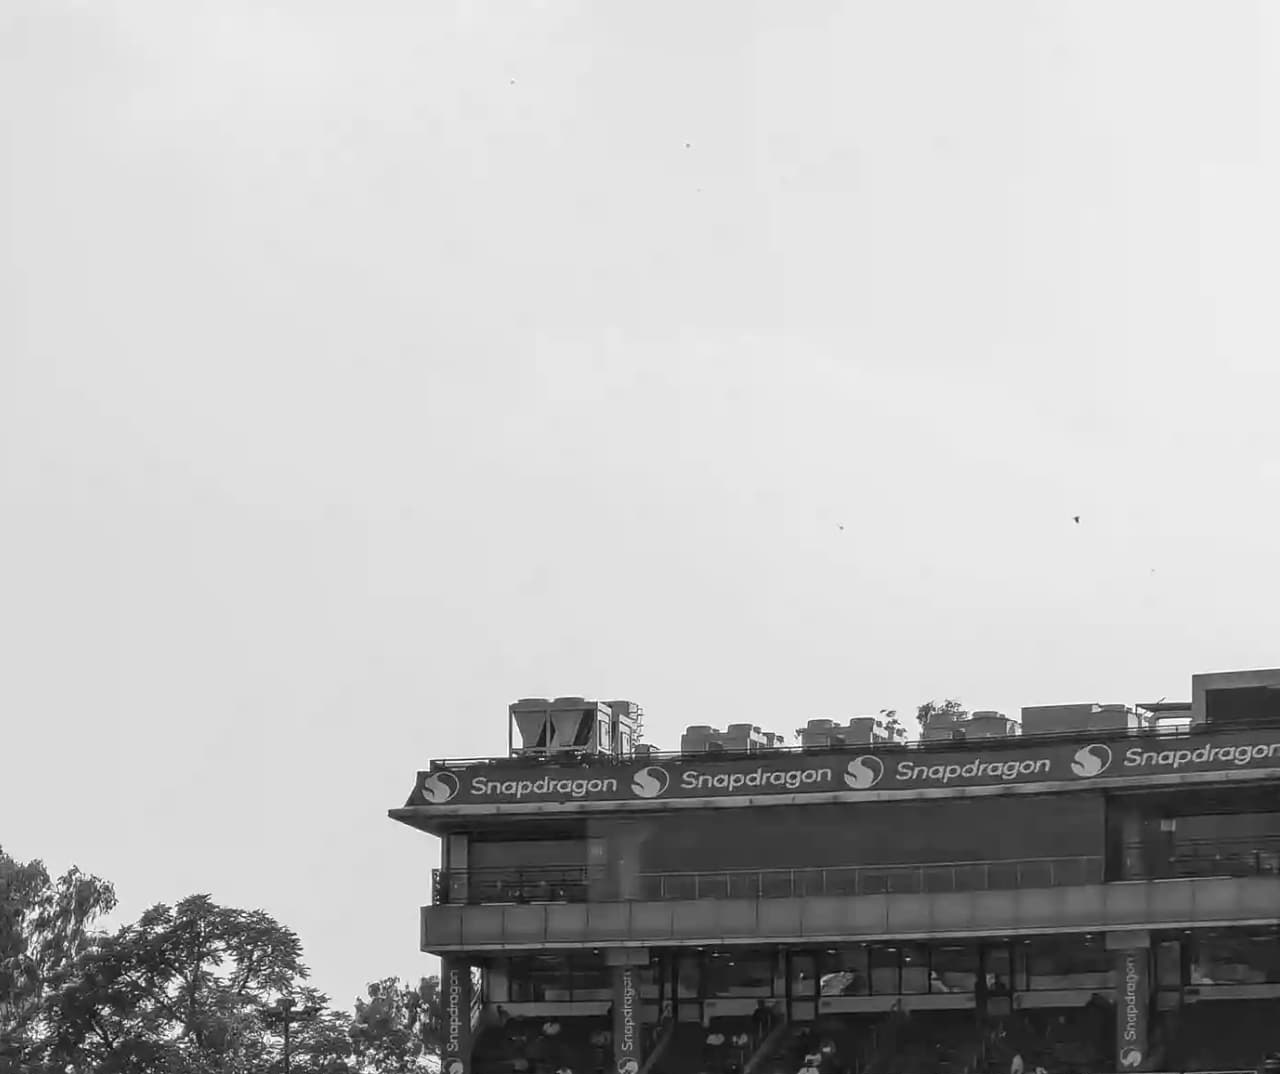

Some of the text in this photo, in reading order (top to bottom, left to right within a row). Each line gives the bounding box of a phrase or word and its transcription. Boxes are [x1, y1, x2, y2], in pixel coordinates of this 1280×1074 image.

[680, 767, 832, 791] Snapdragon
[896, 758, 1050, 783] Snapdragon
[470, 776, 617, 798] Snapdragon
[446, 969, 462, 1051] Snapdragon
